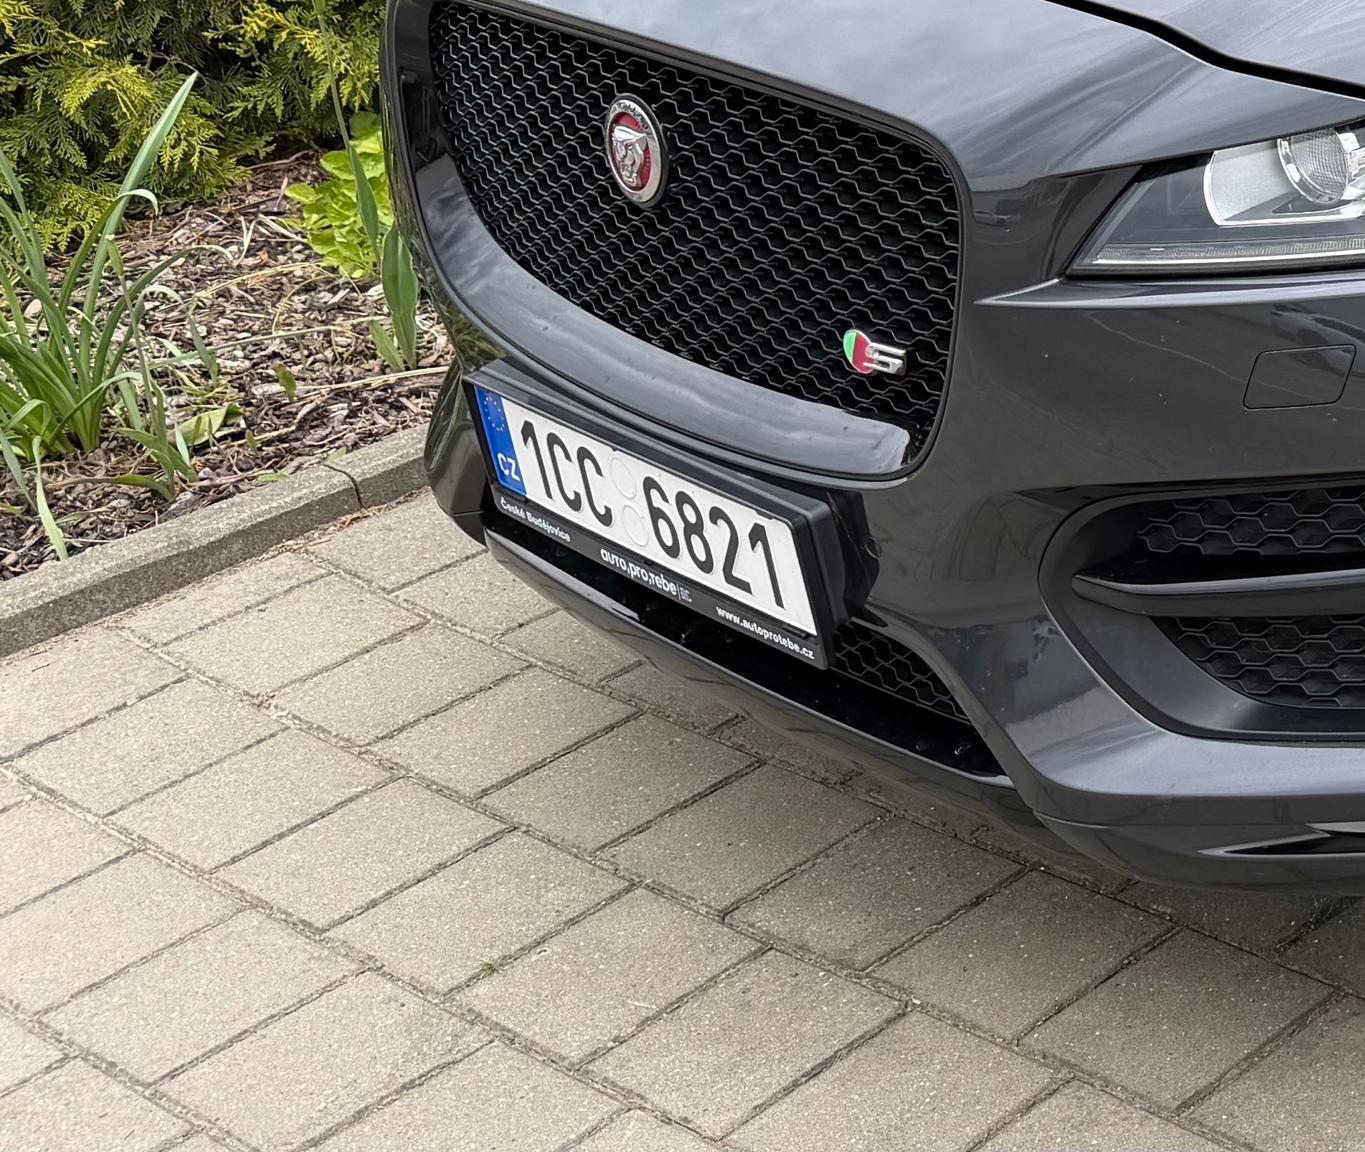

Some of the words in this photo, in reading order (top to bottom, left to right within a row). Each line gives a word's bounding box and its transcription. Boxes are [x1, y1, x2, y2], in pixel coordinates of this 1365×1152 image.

[497, 452, 521, 481] CZ
[521, 419, 613, 528] 1CC
[643, 476, 785, 610] 6821
